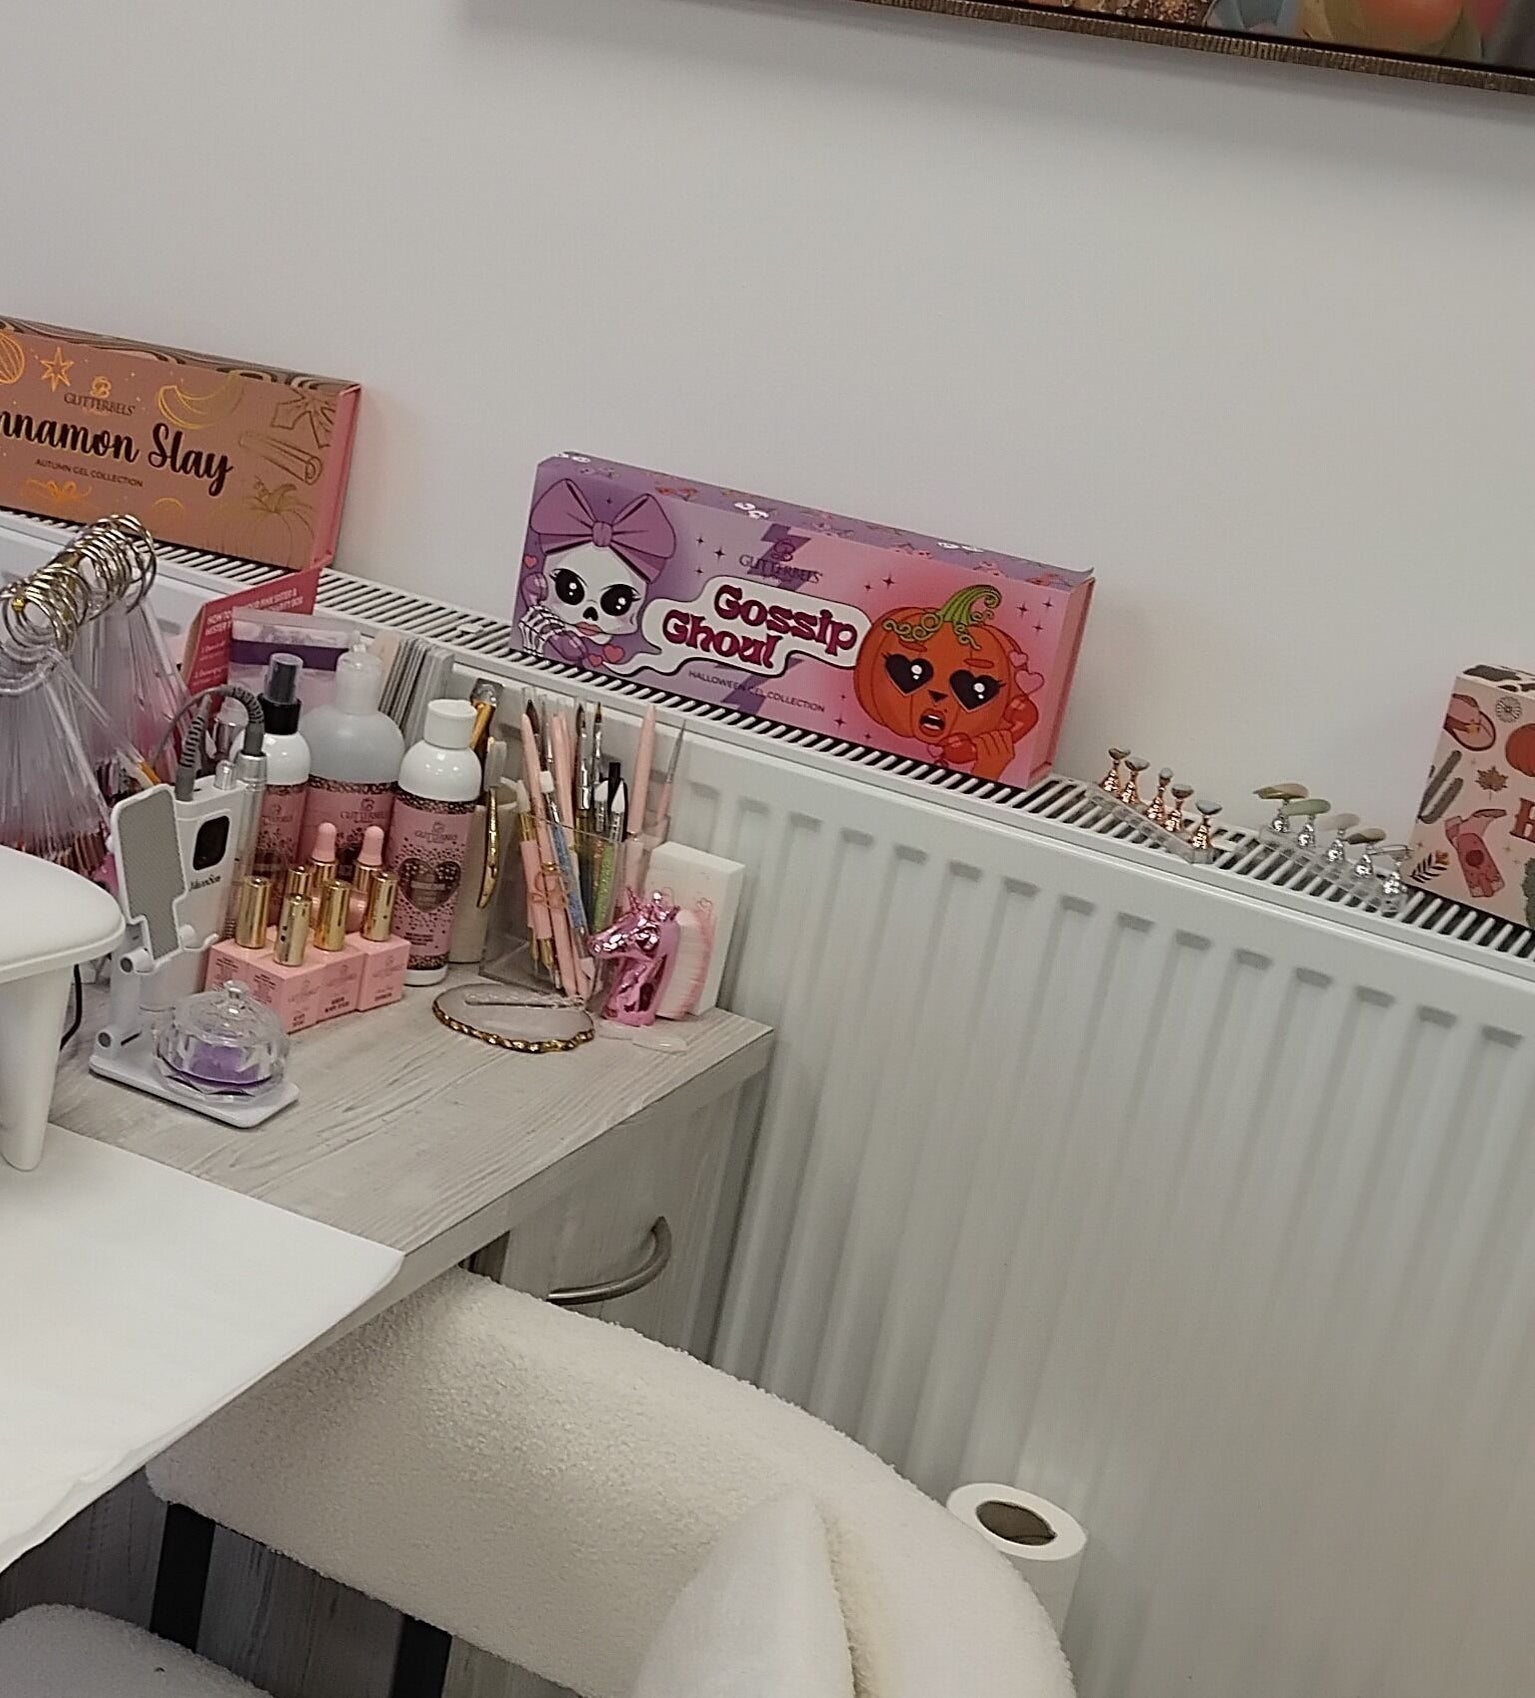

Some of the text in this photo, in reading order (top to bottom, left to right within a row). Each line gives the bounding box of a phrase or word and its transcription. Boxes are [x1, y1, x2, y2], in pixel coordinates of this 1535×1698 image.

[35, 459, 143, 487] AUTUMN GEL COLLECTION
[148, 422, 234, 497] Slay
[662, 609, 783, 669] Ghoul
[714, 584, 858, 656] Gossip
[688, 670, 747, 691] HALLOWEEN
[767, 691, 825, 712] COLLECTION
